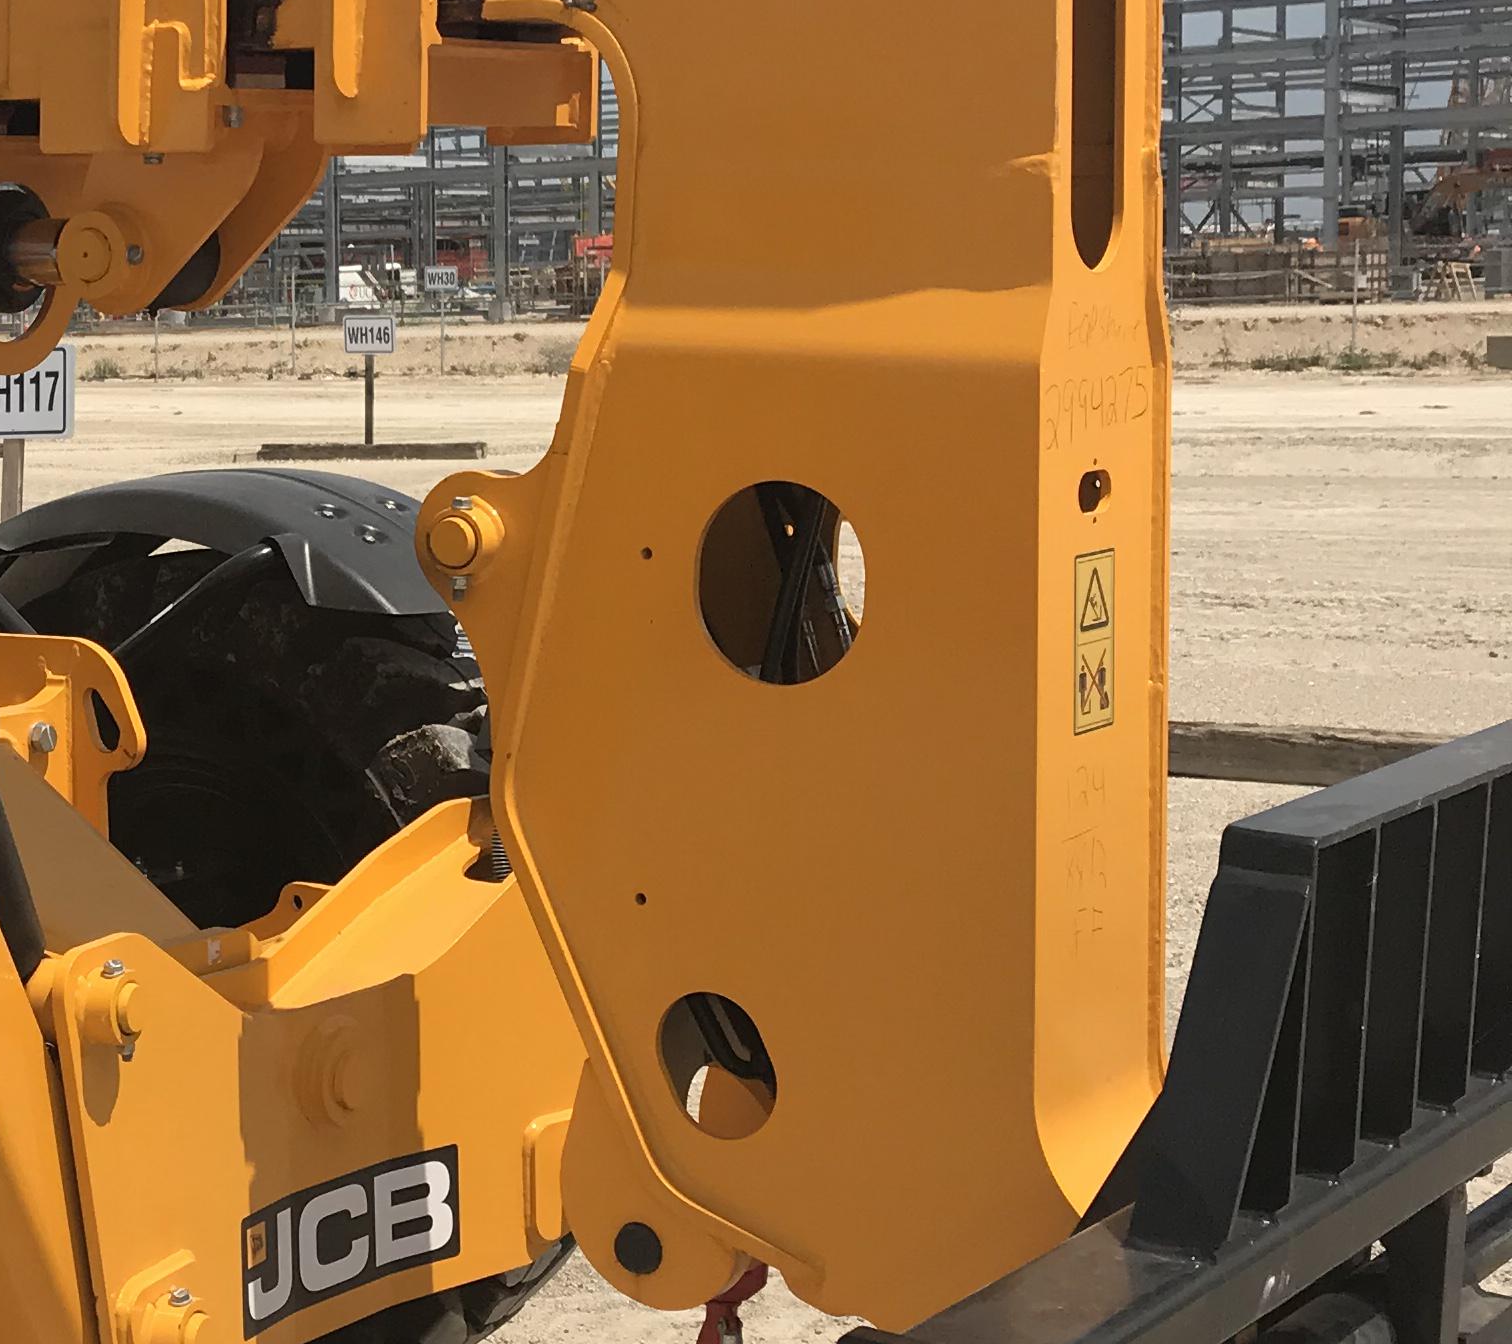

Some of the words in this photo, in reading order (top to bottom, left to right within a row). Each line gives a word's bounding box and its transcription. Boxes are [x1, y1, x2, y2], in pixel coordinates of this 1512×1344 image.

[427, 271, 455, 286] WH30
[347, 325, 390, 345] WH146
[247, 1160, 454, 1321] JCB
